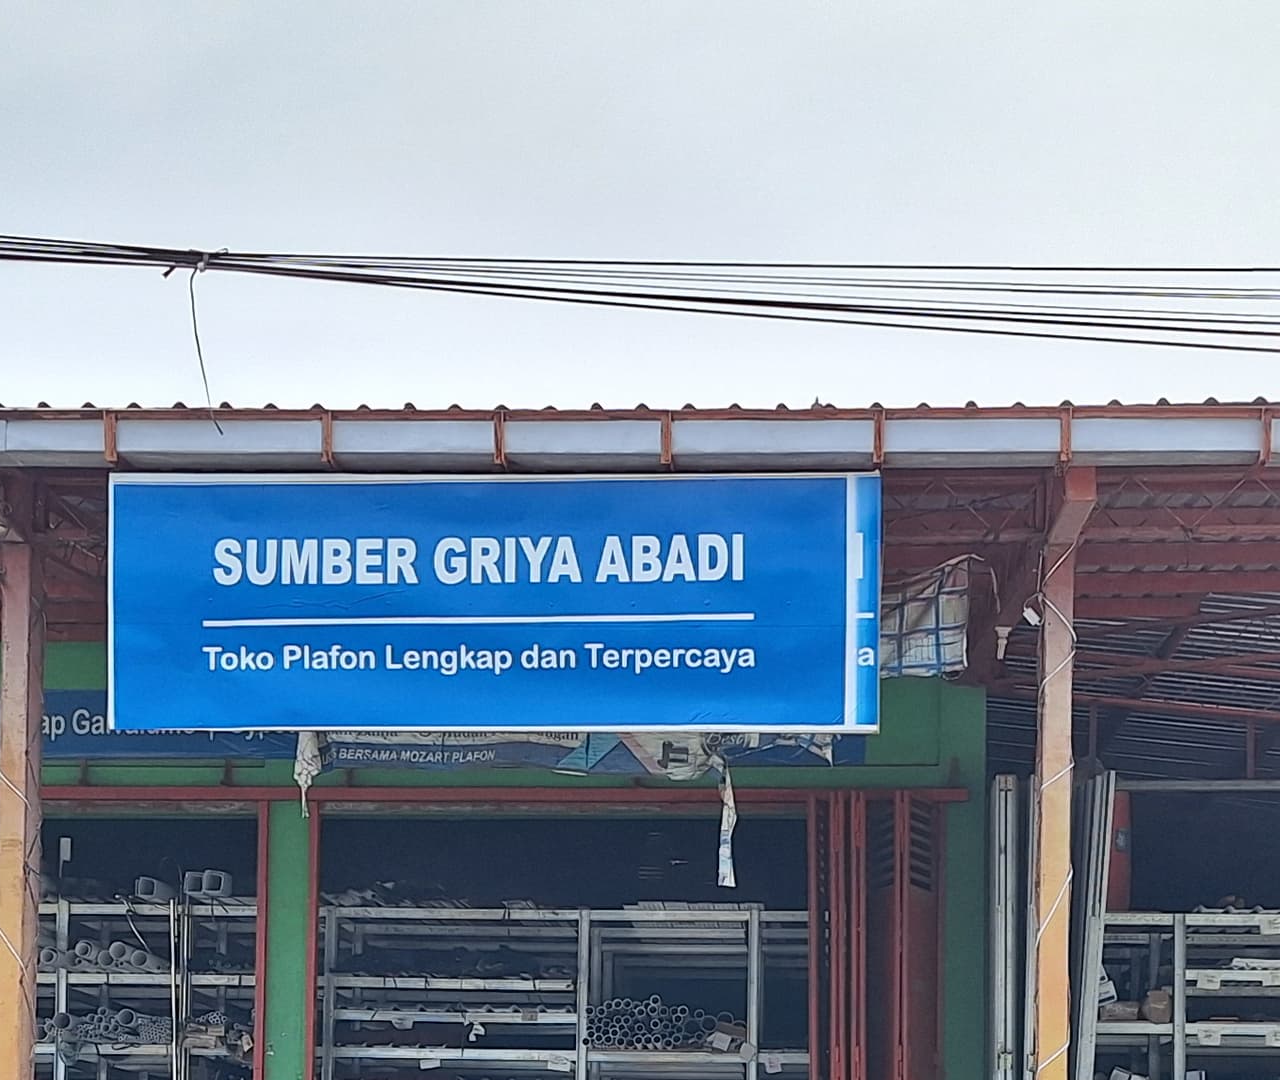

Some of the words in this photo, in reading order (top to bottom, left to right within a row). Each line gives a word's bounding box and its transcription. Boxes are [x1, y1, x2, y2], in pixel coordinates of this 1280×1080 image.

[213, 537, 419, 586] SUMBER
[433, 536, 582, 585] GRIYA
[595, 533, 744, 583] ABADI
[202, 645, 275, 672] Toko
[283, 644, 376, 671] Plafon
[385, 644, 513, 676] Lengkap
[520, 643, 576, 669] dan
[584, 642, 756, 674] Terpercaya
[338, 748, 397, 761] BERSAMA
[400, 749, 450, 763] MOZART
[452, 749, 496, 763] PLAFON
